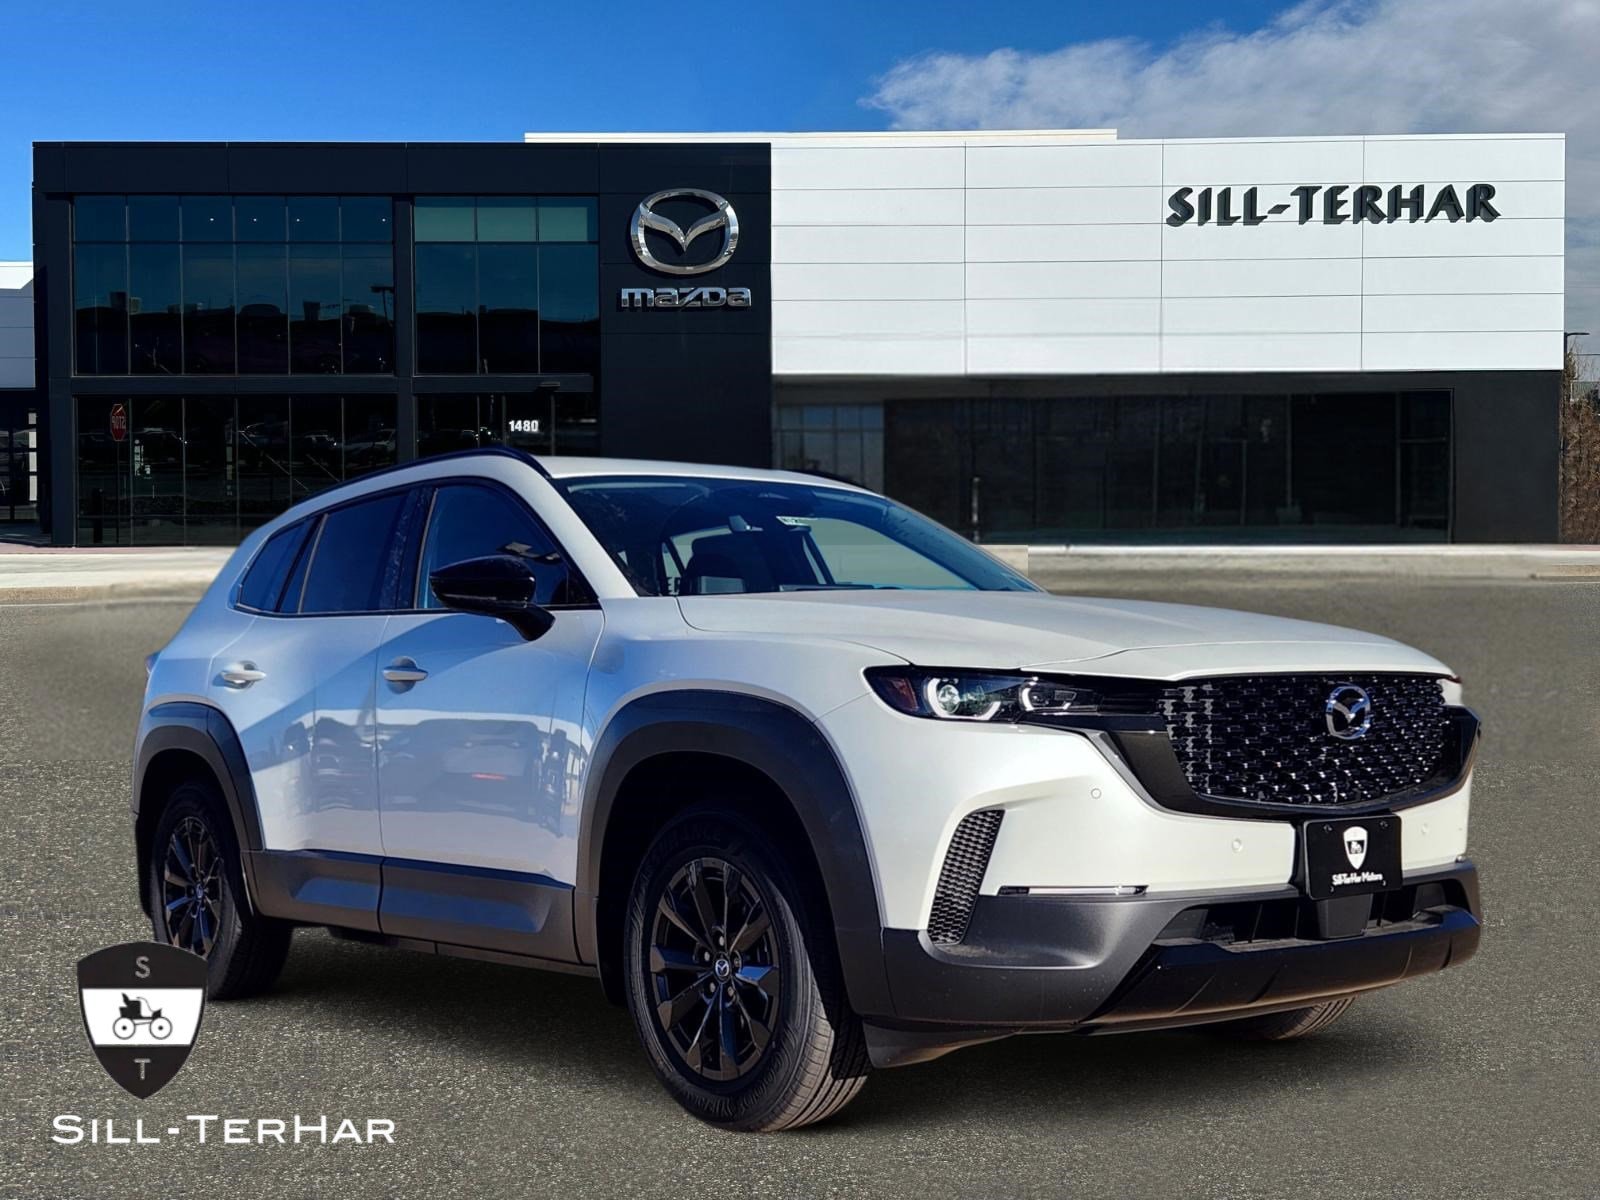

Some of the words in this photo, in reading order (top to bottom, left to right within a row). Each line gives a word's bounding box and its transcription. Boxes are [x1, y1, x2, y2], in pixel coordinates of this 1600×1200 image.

[1166, 183, 1501, 227] SILL-TERHAR
[621, 287, 752, 308] mazda
[508, 419, 539, 432] 1480
